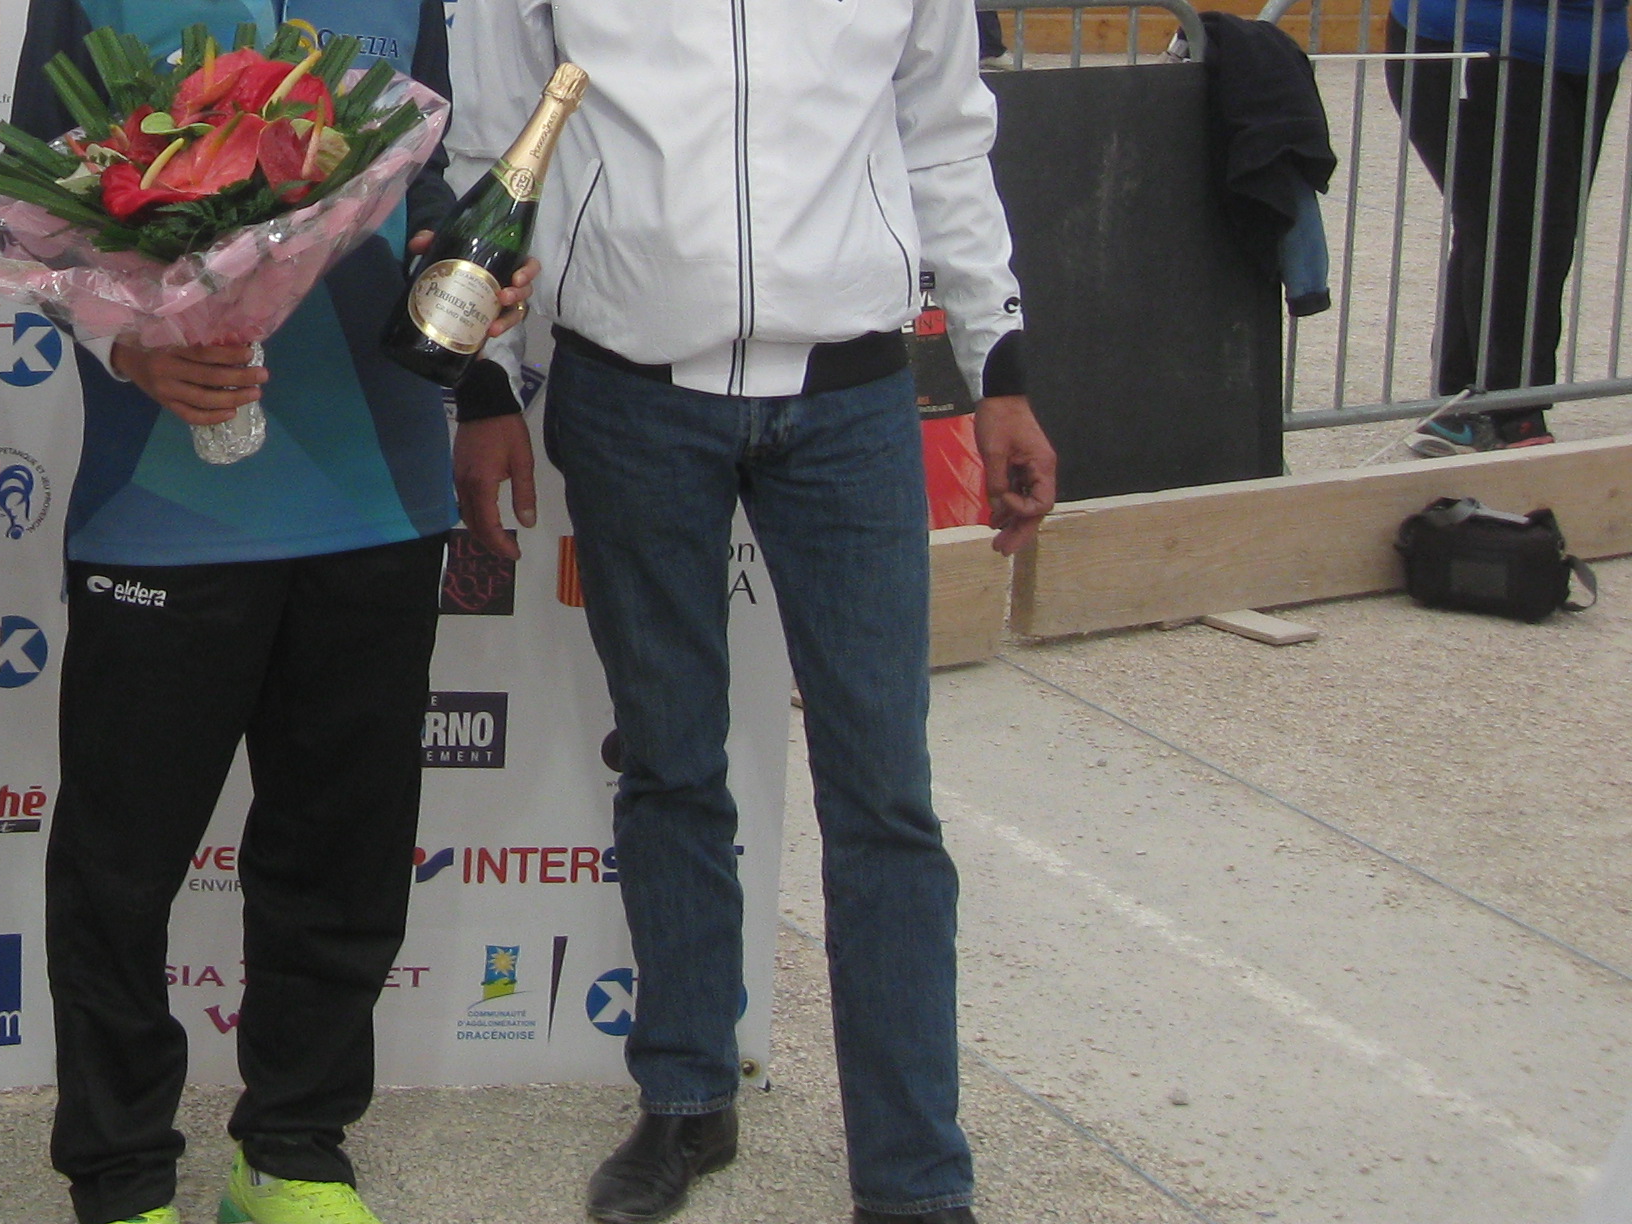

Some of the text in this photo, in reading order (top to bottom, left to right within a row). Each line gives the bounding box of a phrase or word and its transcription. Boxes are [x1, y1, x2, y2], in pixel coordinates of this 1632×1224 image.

[317, 28, 399, 59] OEZZA
[113, 580, 167, 607] eldera
[456, 1029, 536, 1040] DRACÉNOISE
